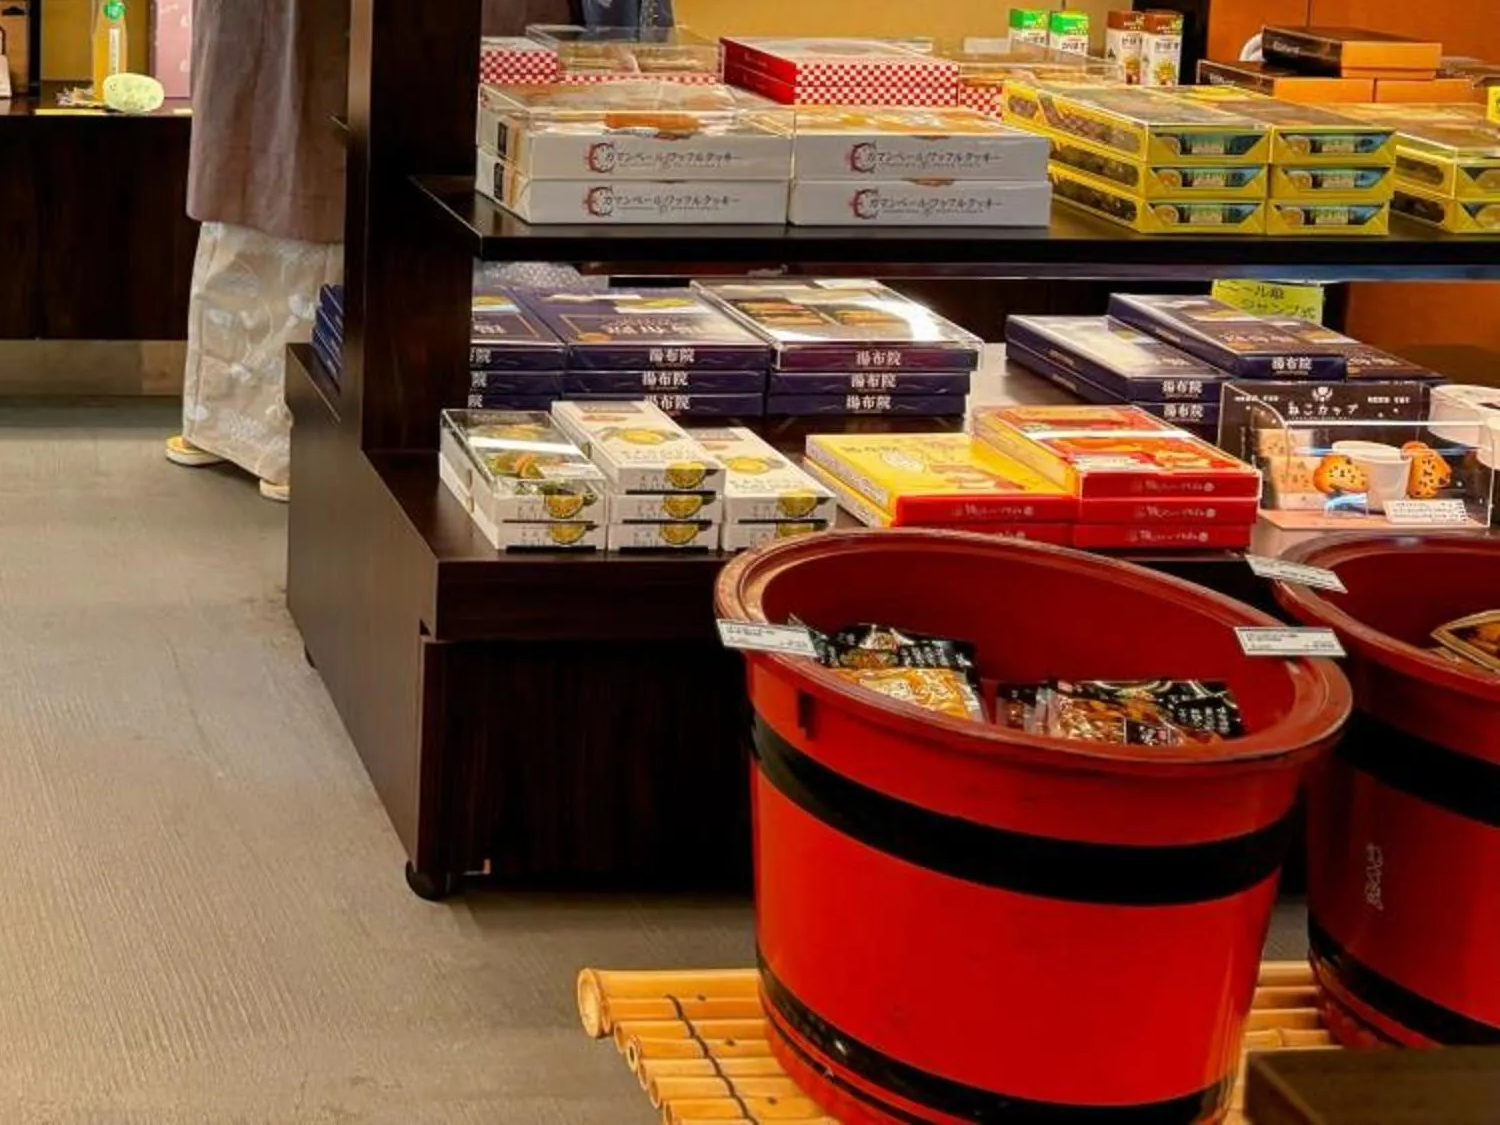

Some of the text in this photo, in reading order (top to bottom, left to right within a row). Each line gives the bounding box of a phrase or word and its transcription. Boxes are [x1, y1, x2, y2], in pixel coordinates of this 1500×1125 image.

[1288, 400, 1359, 416] ねこカップ
